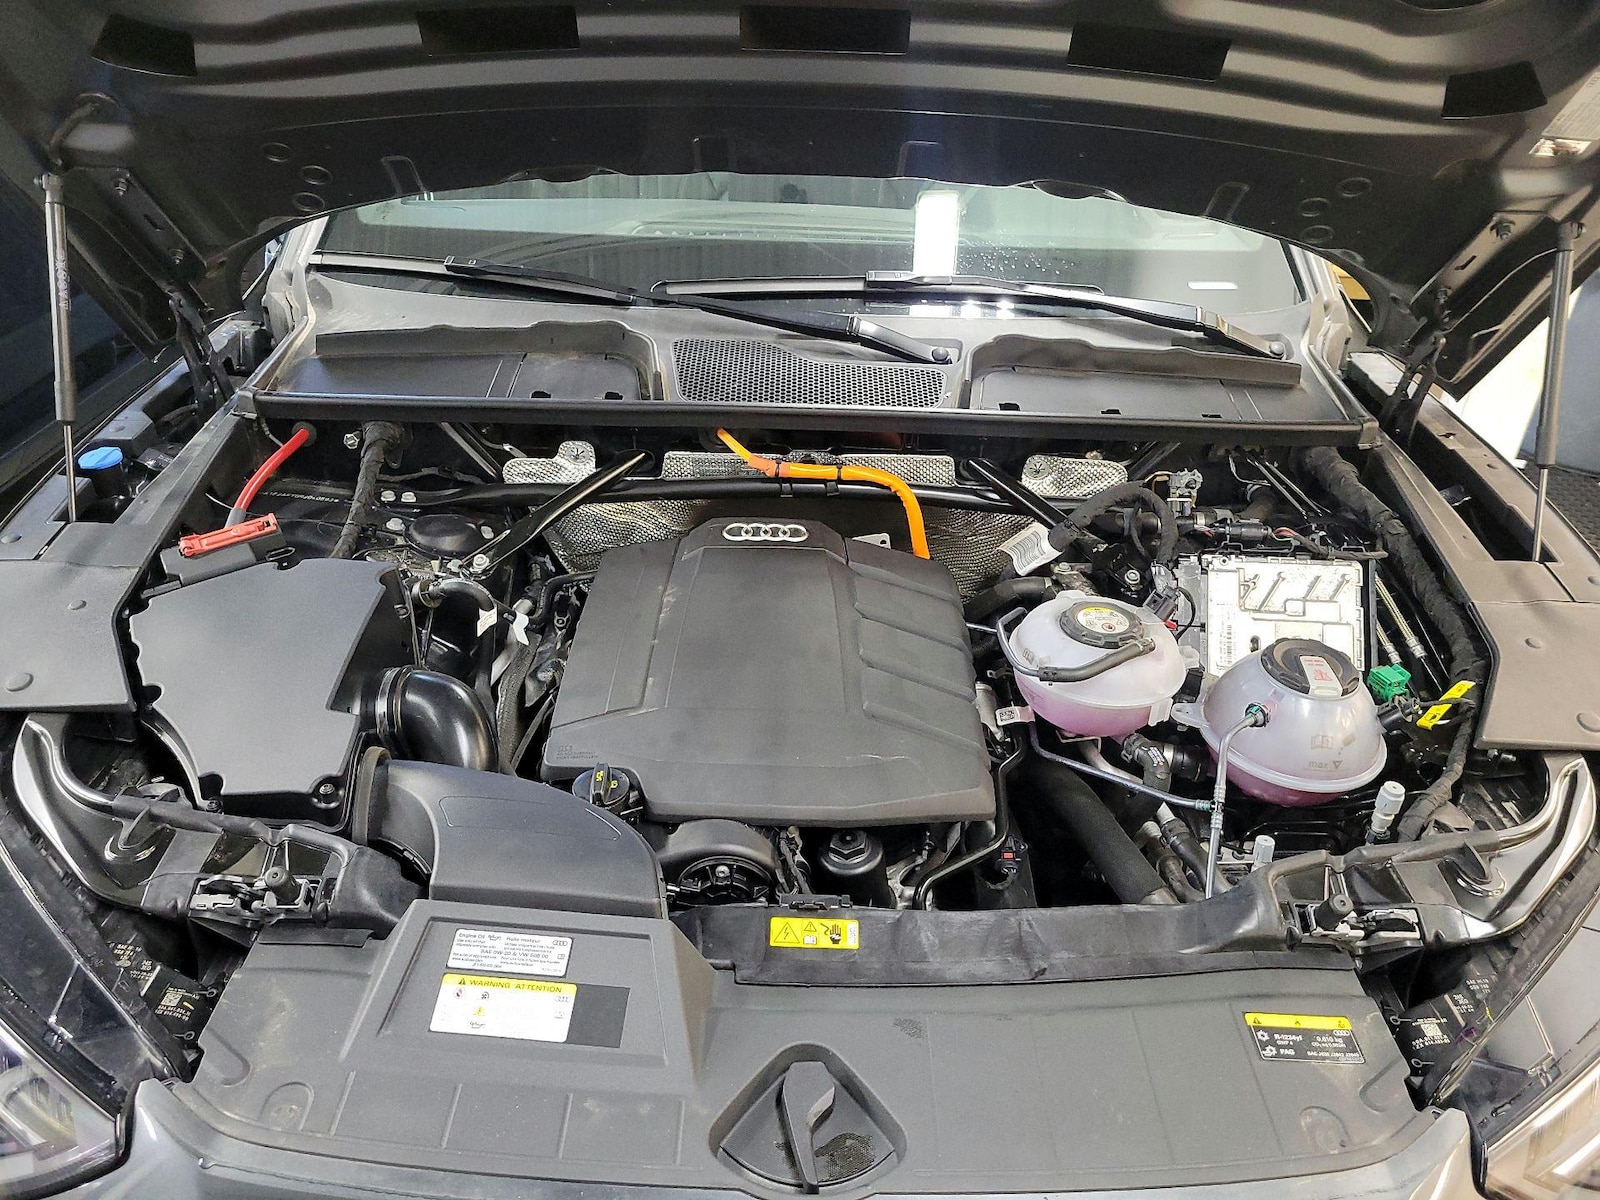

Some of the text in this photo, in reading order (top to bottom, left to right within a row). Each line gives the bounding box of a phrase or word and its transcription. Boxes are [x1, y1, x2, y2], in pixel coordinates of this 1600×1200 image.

[1308, 761, 1328, 769] max
[469, 979, 563, 993] WARNING ATTENTION
